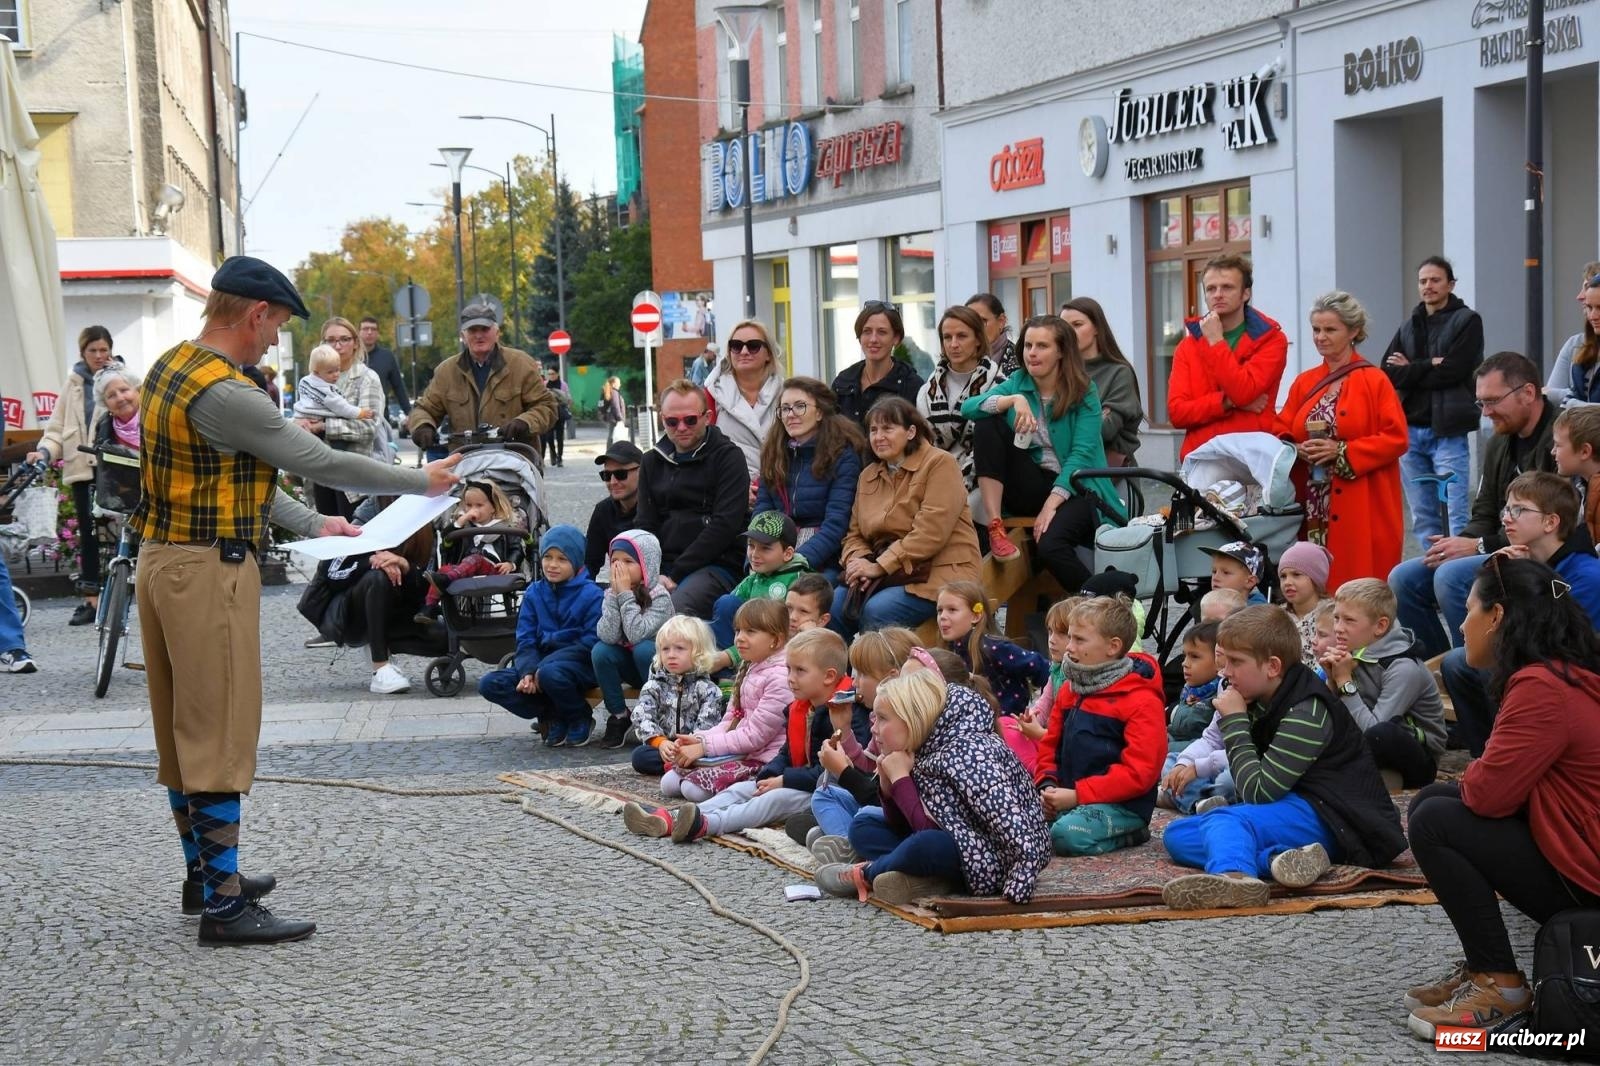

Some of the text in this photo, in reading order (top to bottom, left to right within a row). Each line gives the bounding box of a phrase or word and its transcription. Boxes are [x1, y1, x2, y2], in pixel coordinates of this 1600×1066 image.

[1344, 36, 1423, 95] BOLKO
[1480, 15, 1583, 68] RACIBSKA
[1107, 82, 1213, 145] JUBILER
[814, 121, 901, 188] zaprasza
[1124, 147, 1203, 181] ZEGARMISTRZ
